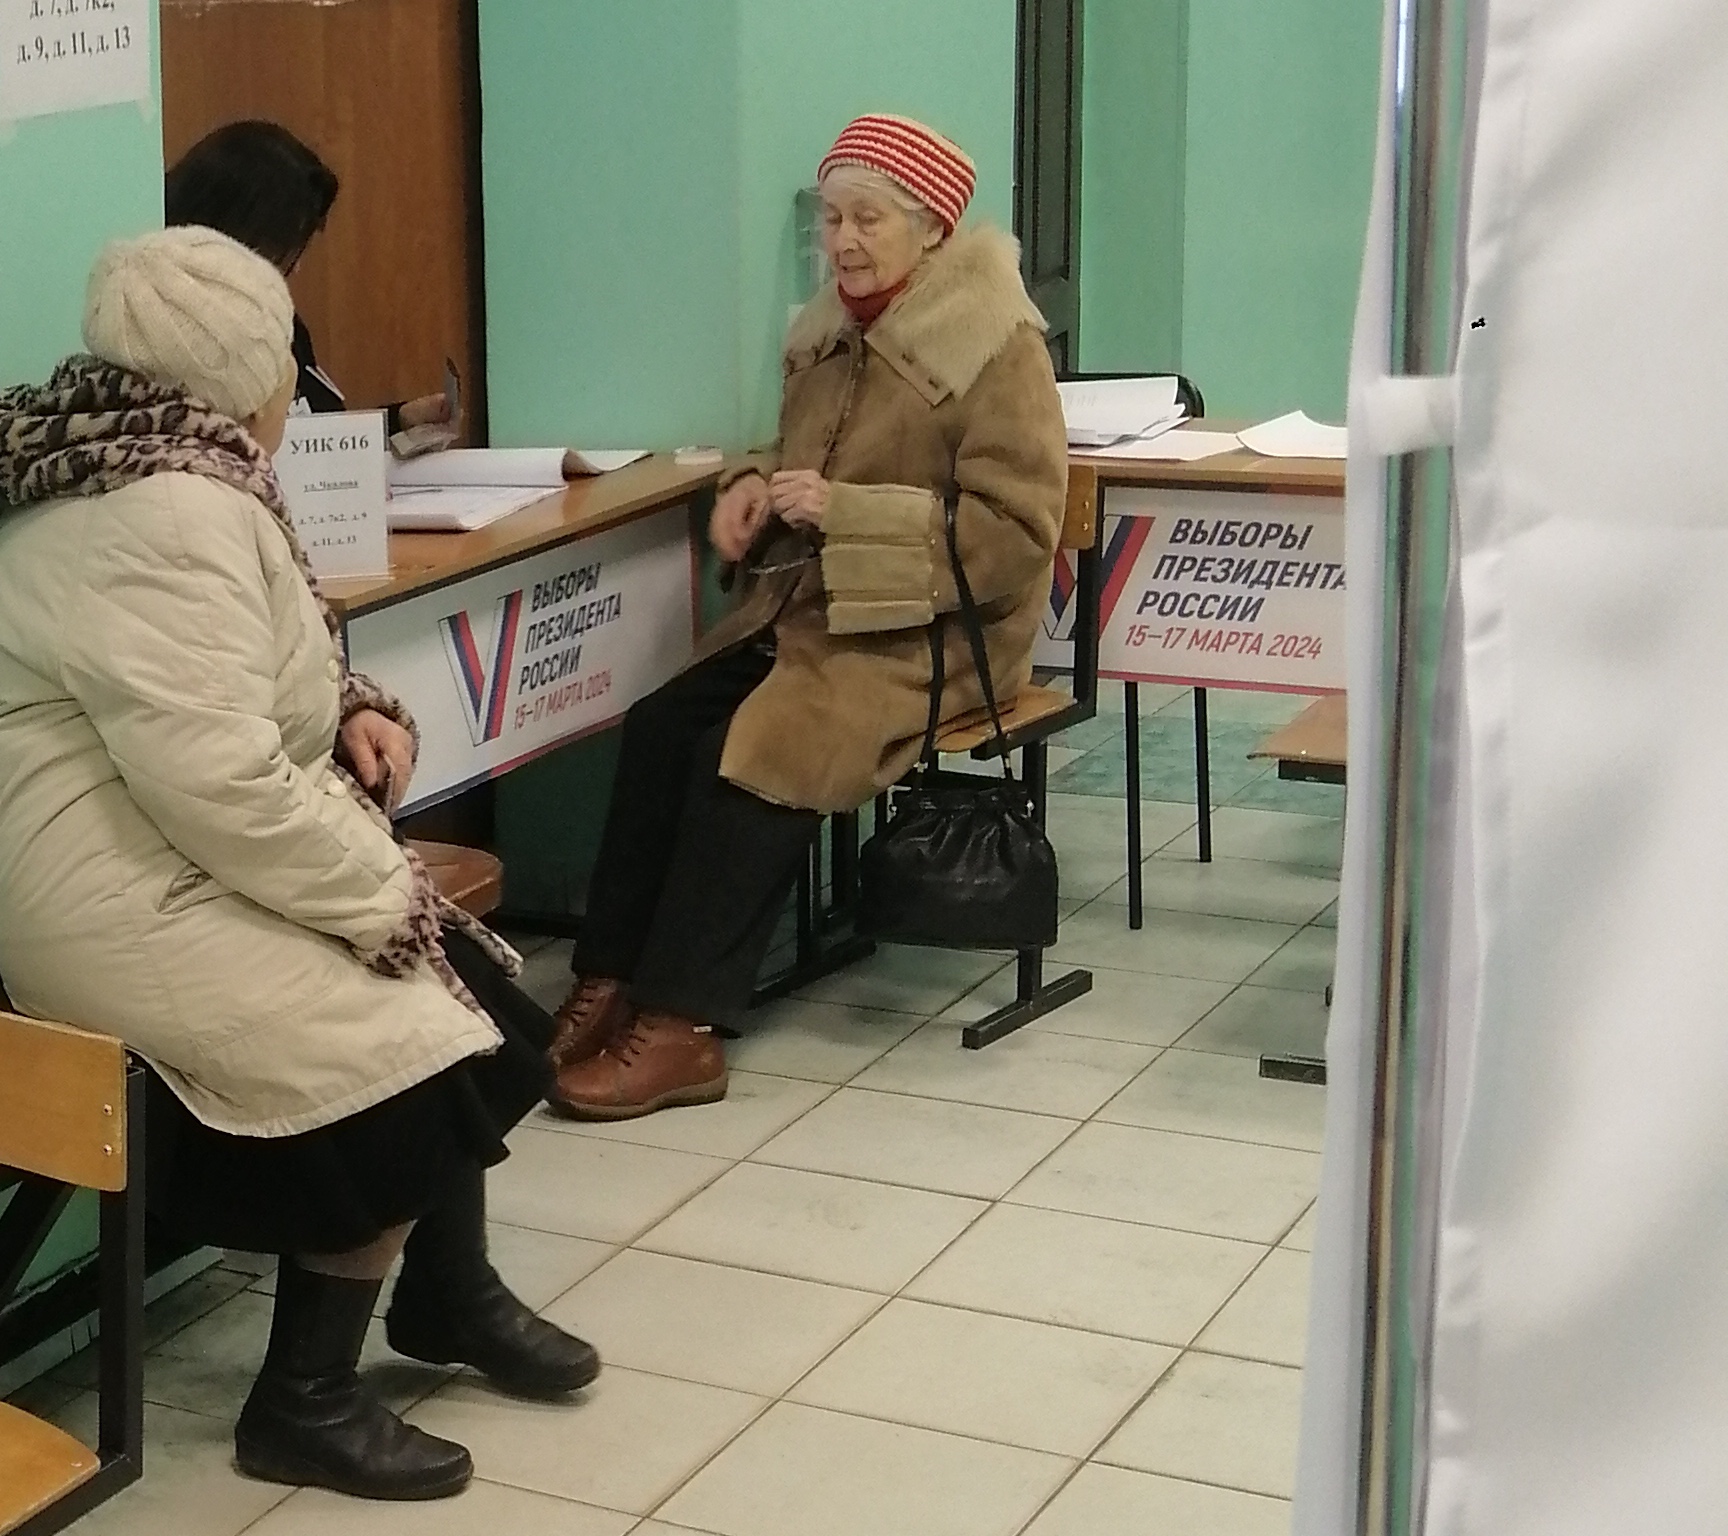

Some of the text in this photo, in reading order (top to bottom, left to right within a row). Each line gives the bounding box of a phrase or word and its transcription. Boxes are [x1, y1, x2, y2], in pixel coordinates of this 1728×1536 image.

[30, 0, 44, 20] д.
[17, 25, 131, 65] д. 9, д. 11, д. 13
[290, 435, 369, 455] УИК 616
[1168, 518, 1314, 551] ВЫБОРЫ
[531, 562, 602, 613] ВЫБОРЫ
[524, 592, 622, 654] ПРЕЗИДЕНТА
[1136, 590, 1265, 623] РОССИИ
[1186, 628, 1264, 655] МАРТА
[1266, 634, 1323, 660] 2024
[517, 644, 582, 695] РОССИИ
[546, 681, 583, 717] МАРТА
[585, 668, 612, 701] 2024
